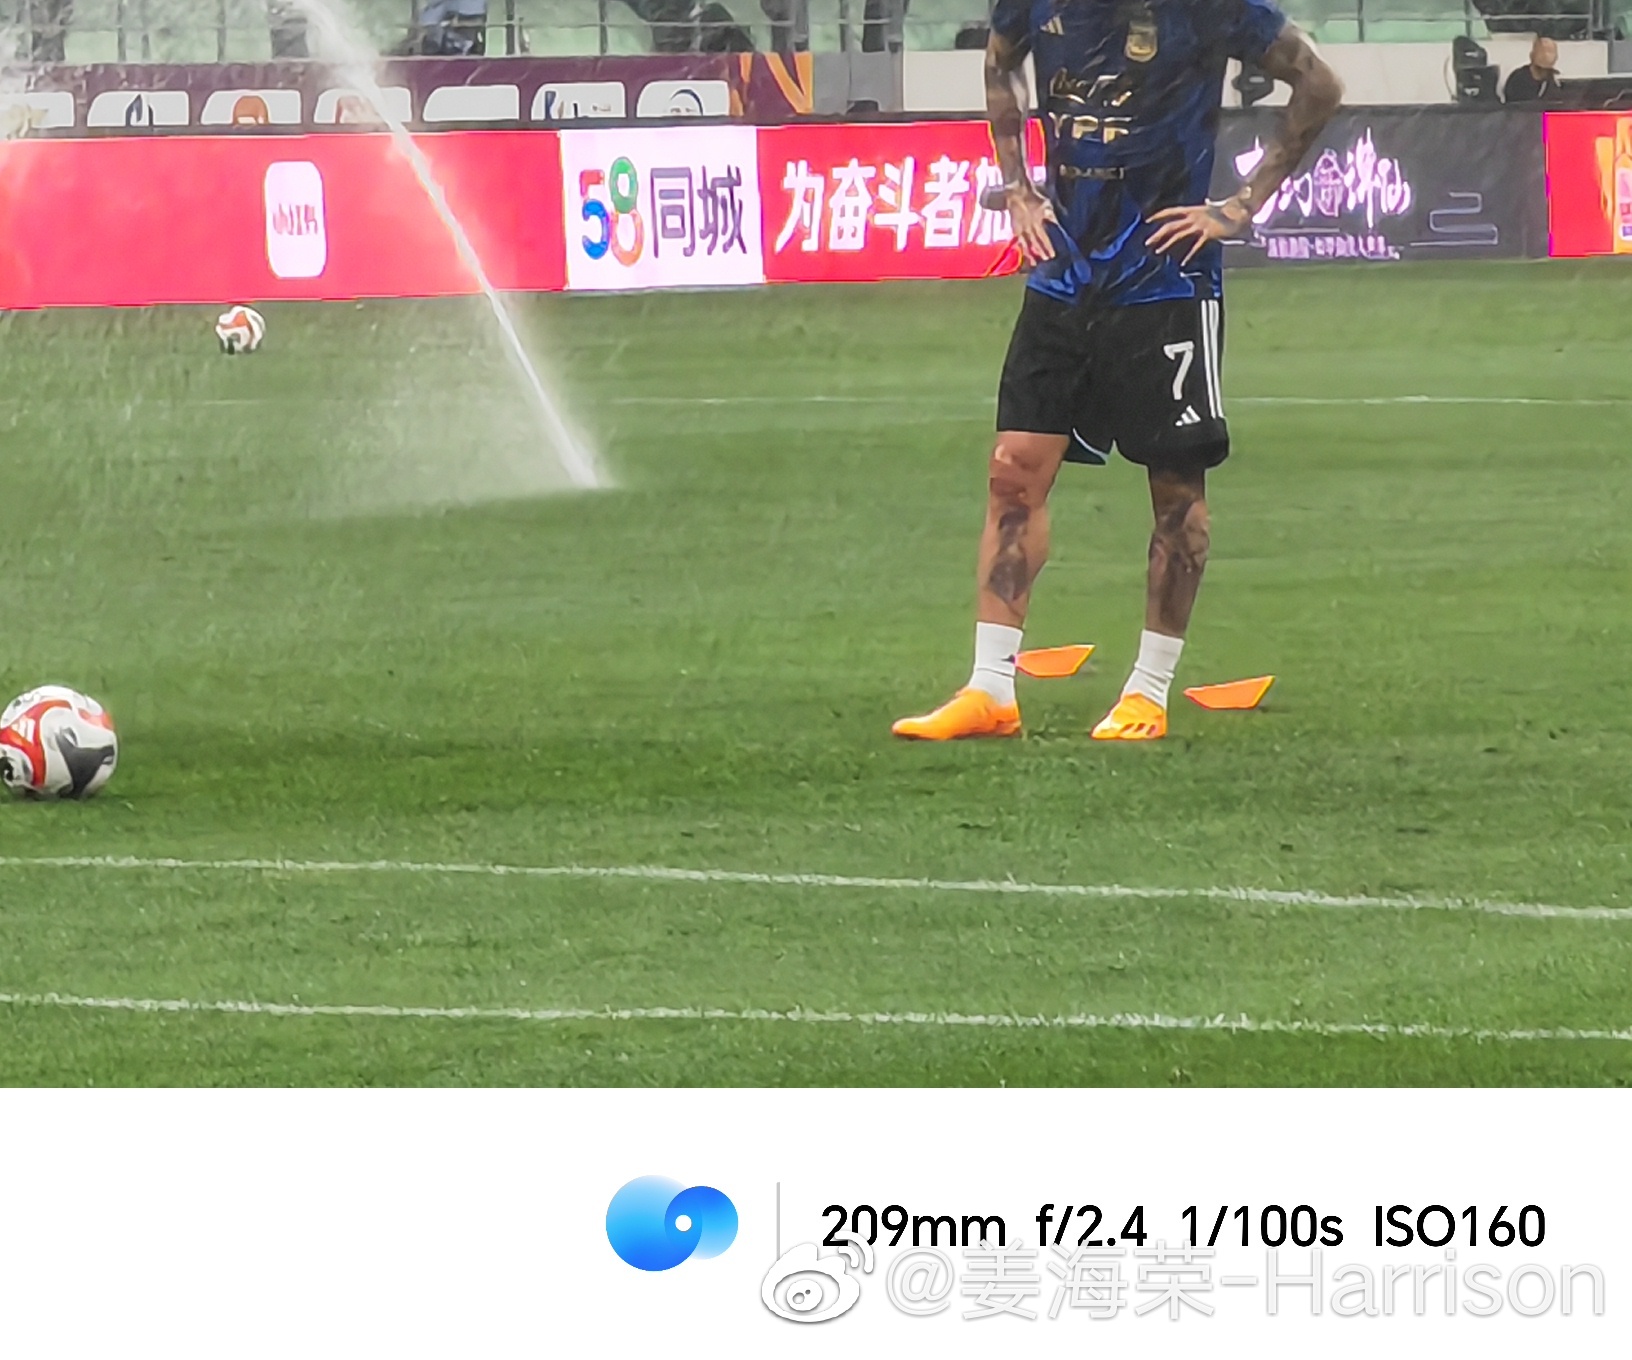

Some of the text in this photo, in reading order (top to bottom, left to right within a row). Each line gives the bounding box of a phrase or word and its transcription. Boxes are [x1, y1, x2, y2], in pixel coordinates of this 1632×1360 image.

[1048, 111, 1133, 144] YPF
[579, 156, 747, 267] 58同城
[775, 155, 1046, 253] 为奋斗者加
[1163, 341, 1195, 400] 7
